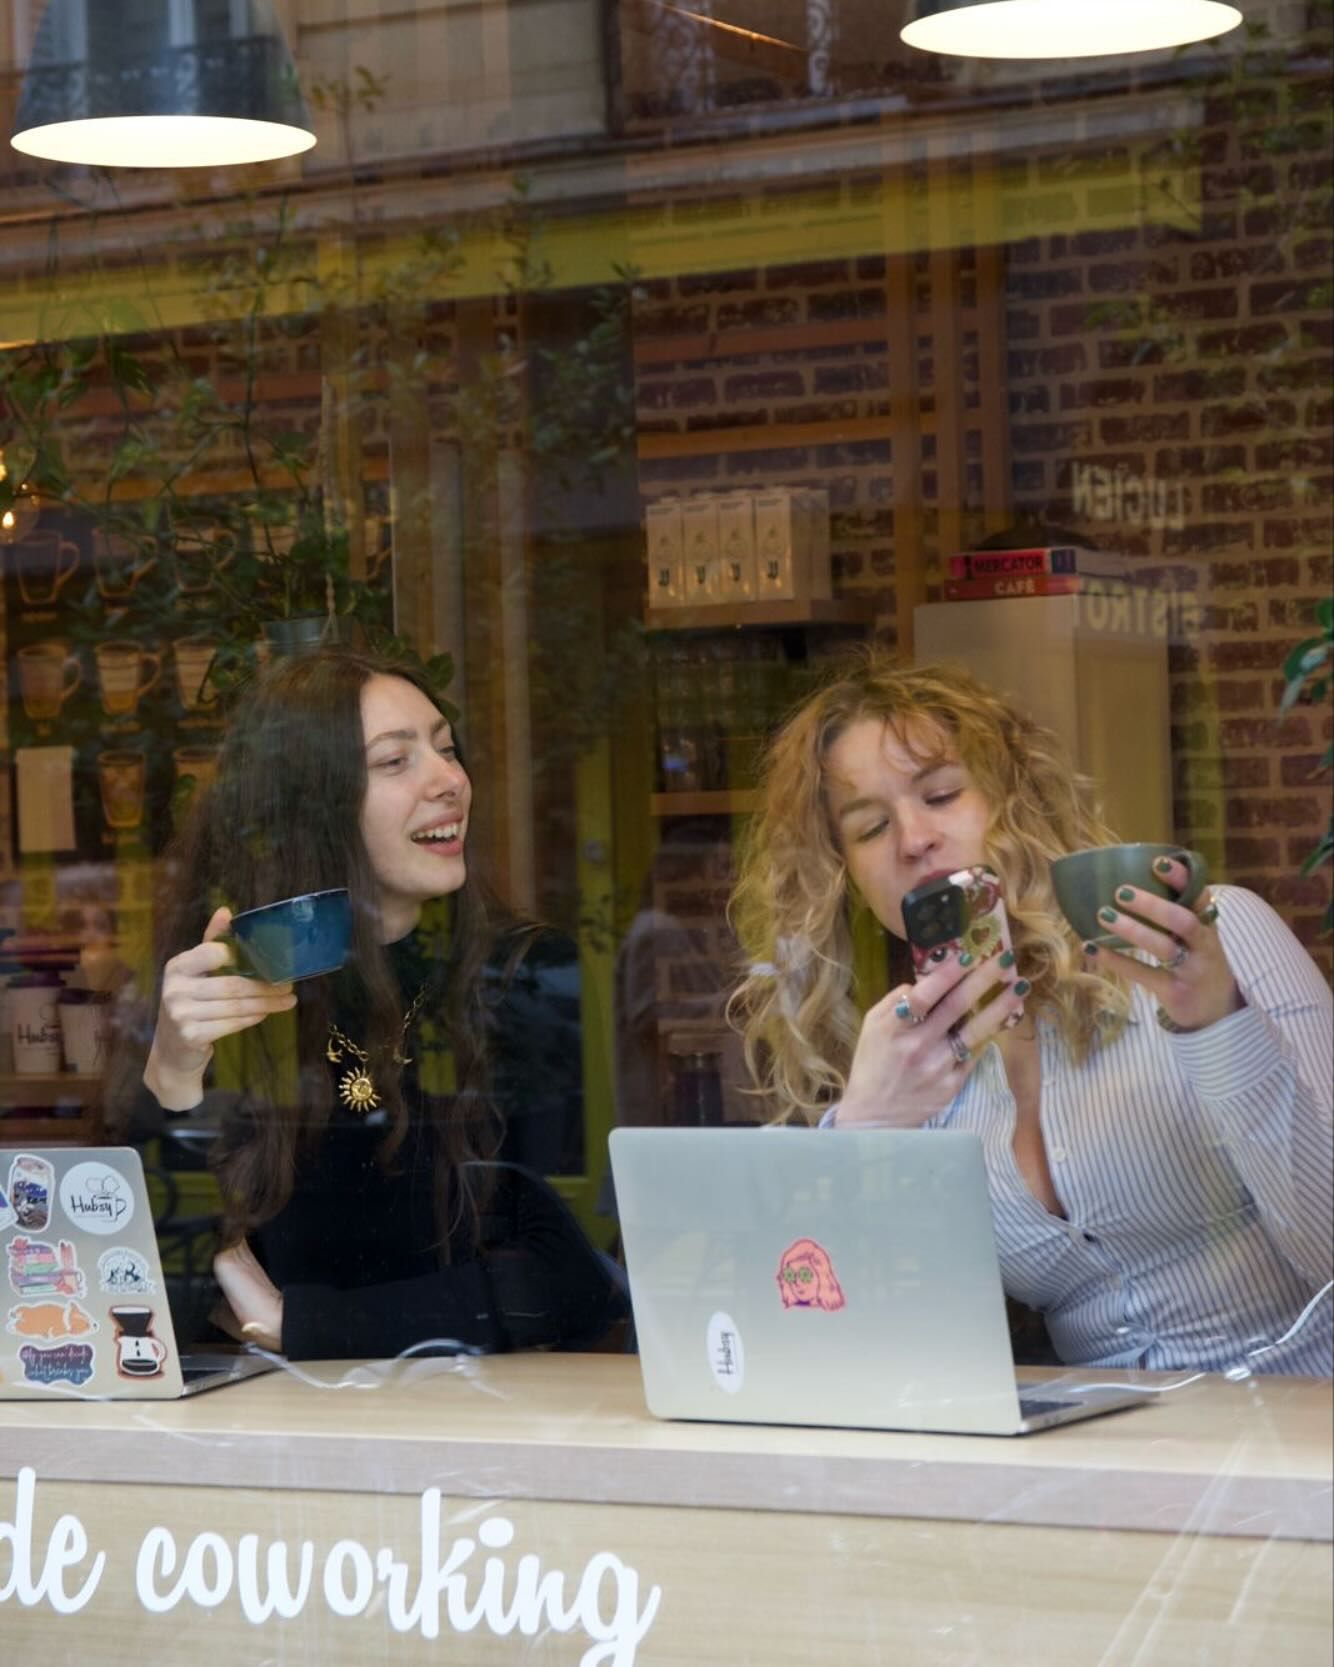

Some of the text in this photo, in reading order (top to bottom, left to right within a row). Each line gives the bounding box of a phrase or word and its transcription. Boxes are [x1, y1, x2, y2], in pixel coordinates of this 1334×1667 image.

[975, 555, 1041, 574] MERCATOR
[71, 1194, 112, 1216] Hubsy
[0, 1467, 661, 1667] de coworking
